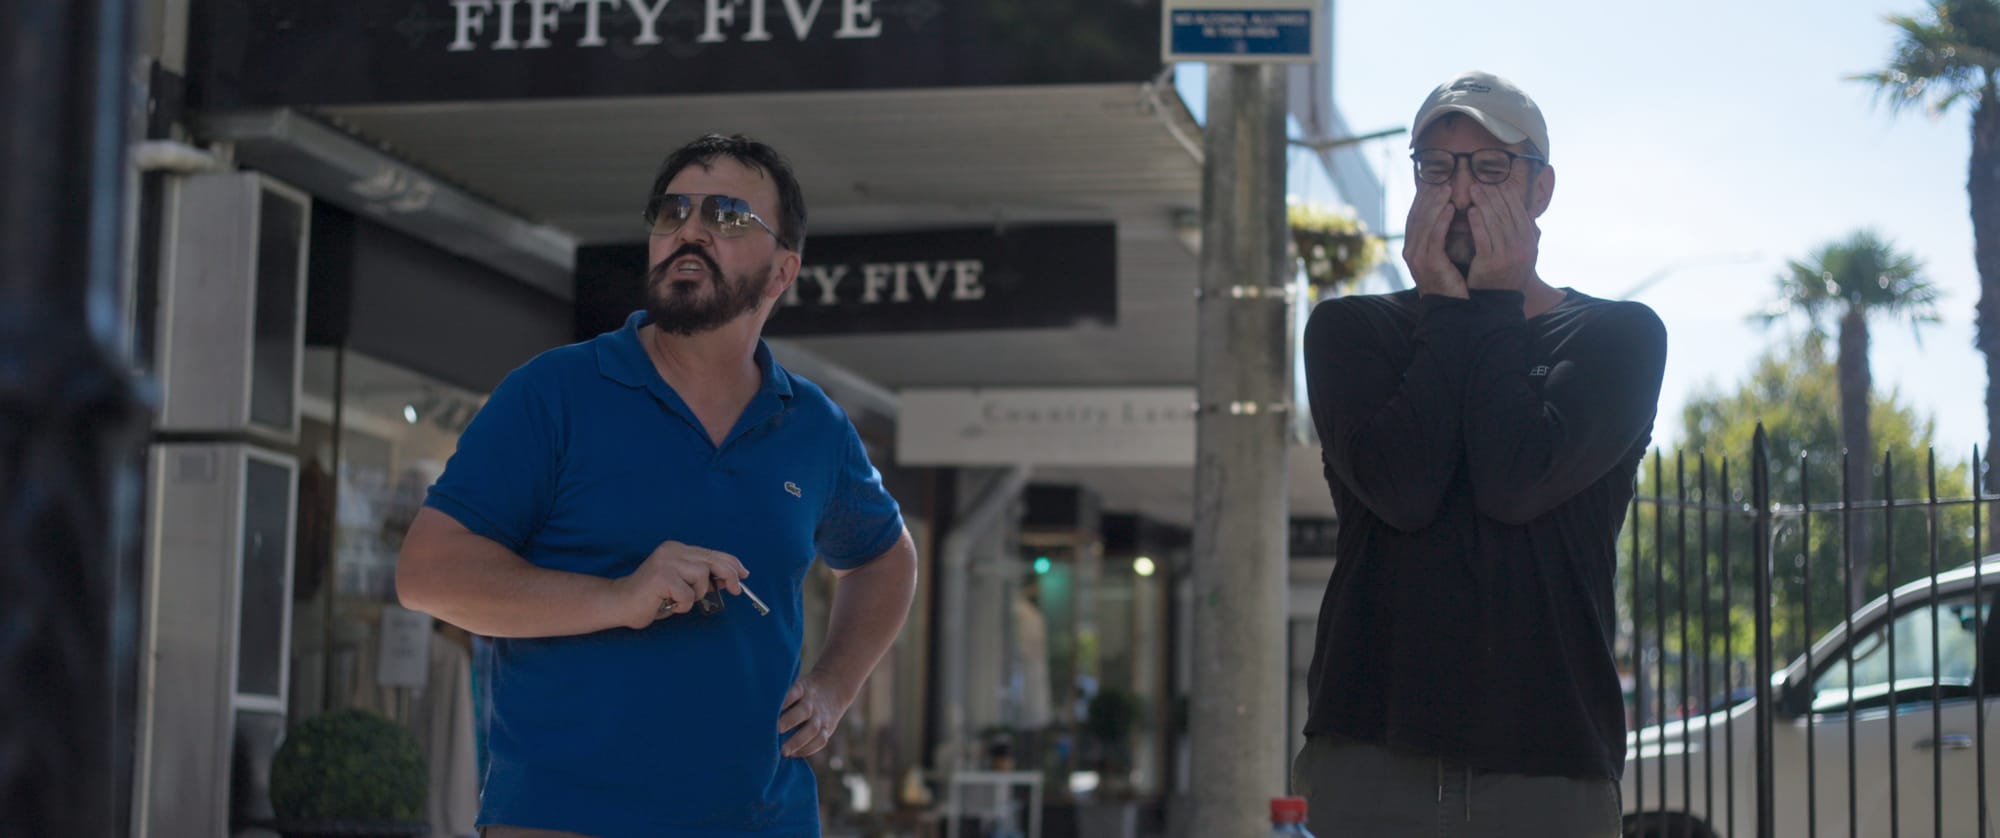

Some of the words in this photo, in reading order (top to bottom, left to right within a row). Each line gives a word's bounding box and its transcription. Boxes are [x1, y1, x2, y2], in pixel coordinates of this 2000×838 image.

[446, 0, 668, 51] FIFTY
[697, 0, 882, 42] FIVE
[861, 260, 985, 304] FIVE
